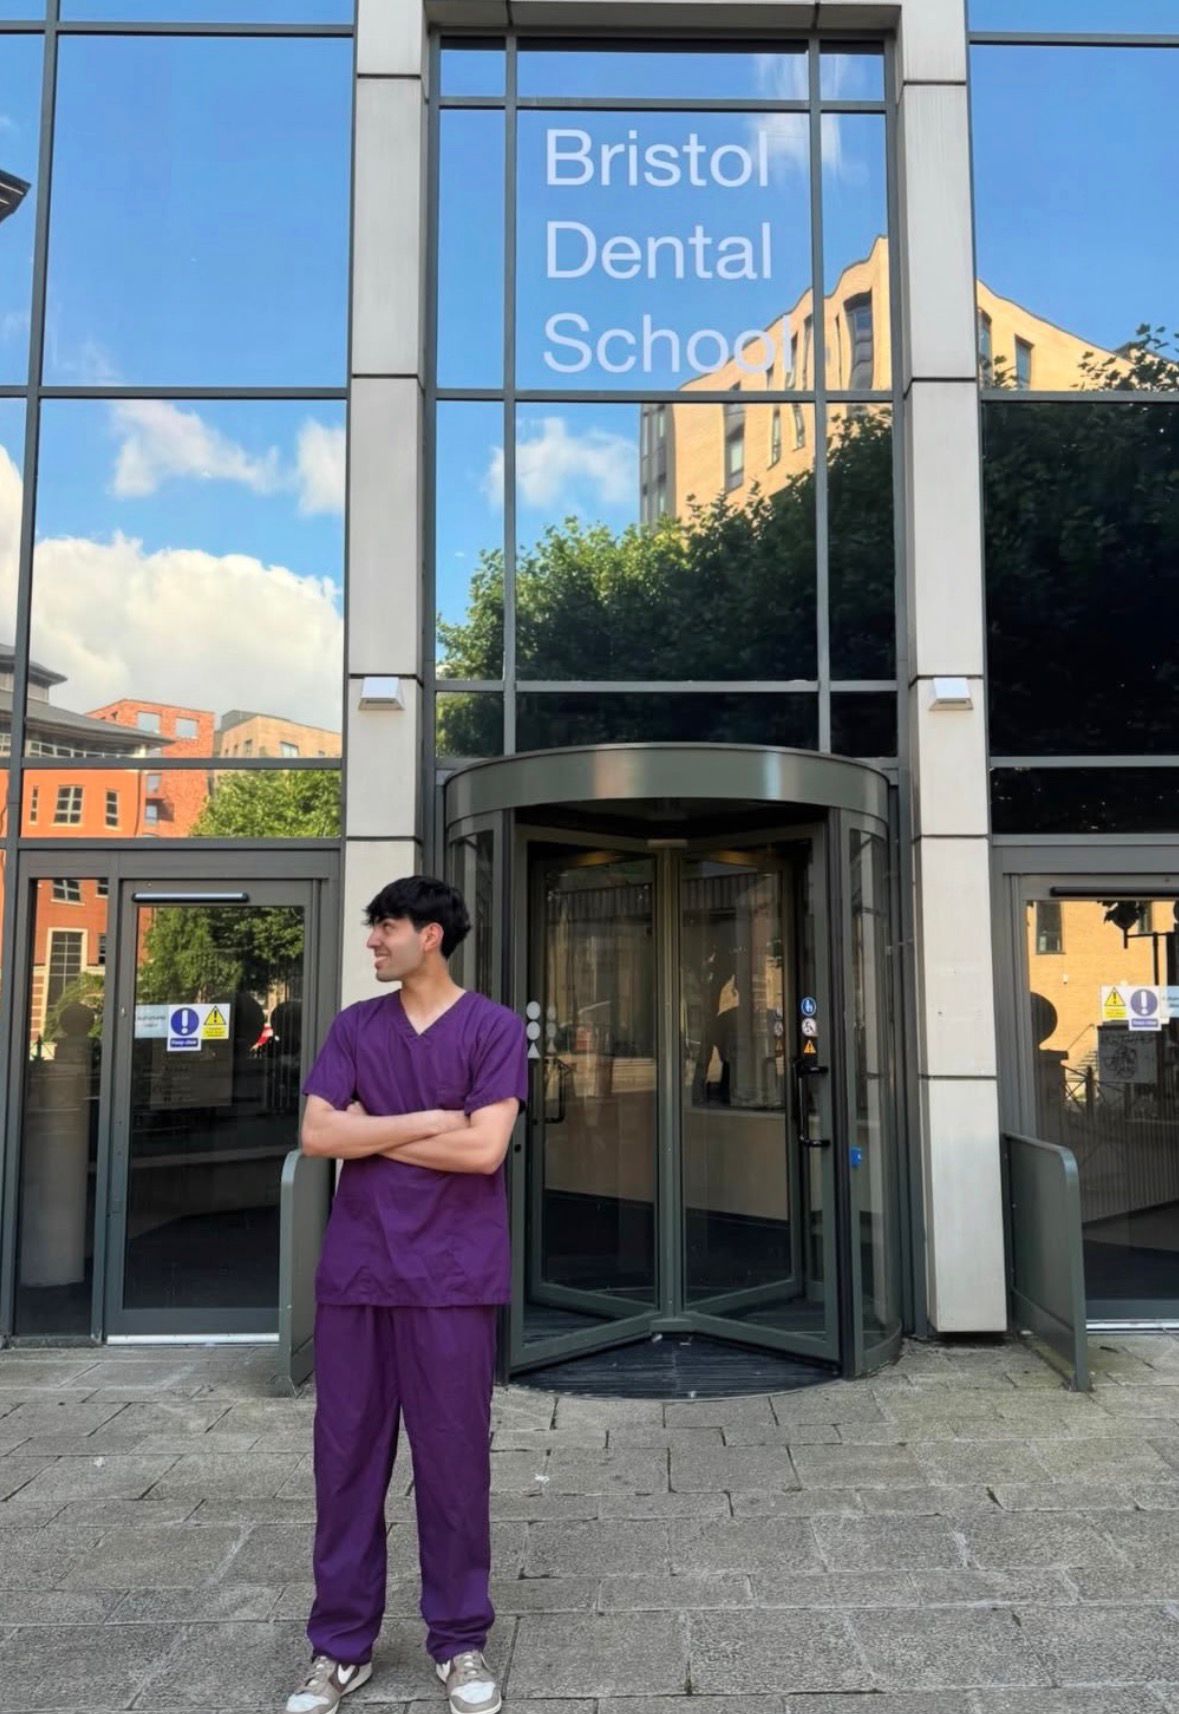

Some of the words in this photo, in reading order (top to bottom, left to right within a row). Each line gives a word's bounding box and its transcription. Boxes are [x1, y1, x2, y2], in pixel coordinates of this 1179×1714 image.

[546, 129, 768, 187] Bristol
[546, 221, 771, 279] Dental
[543, 313, 794, 373] School
